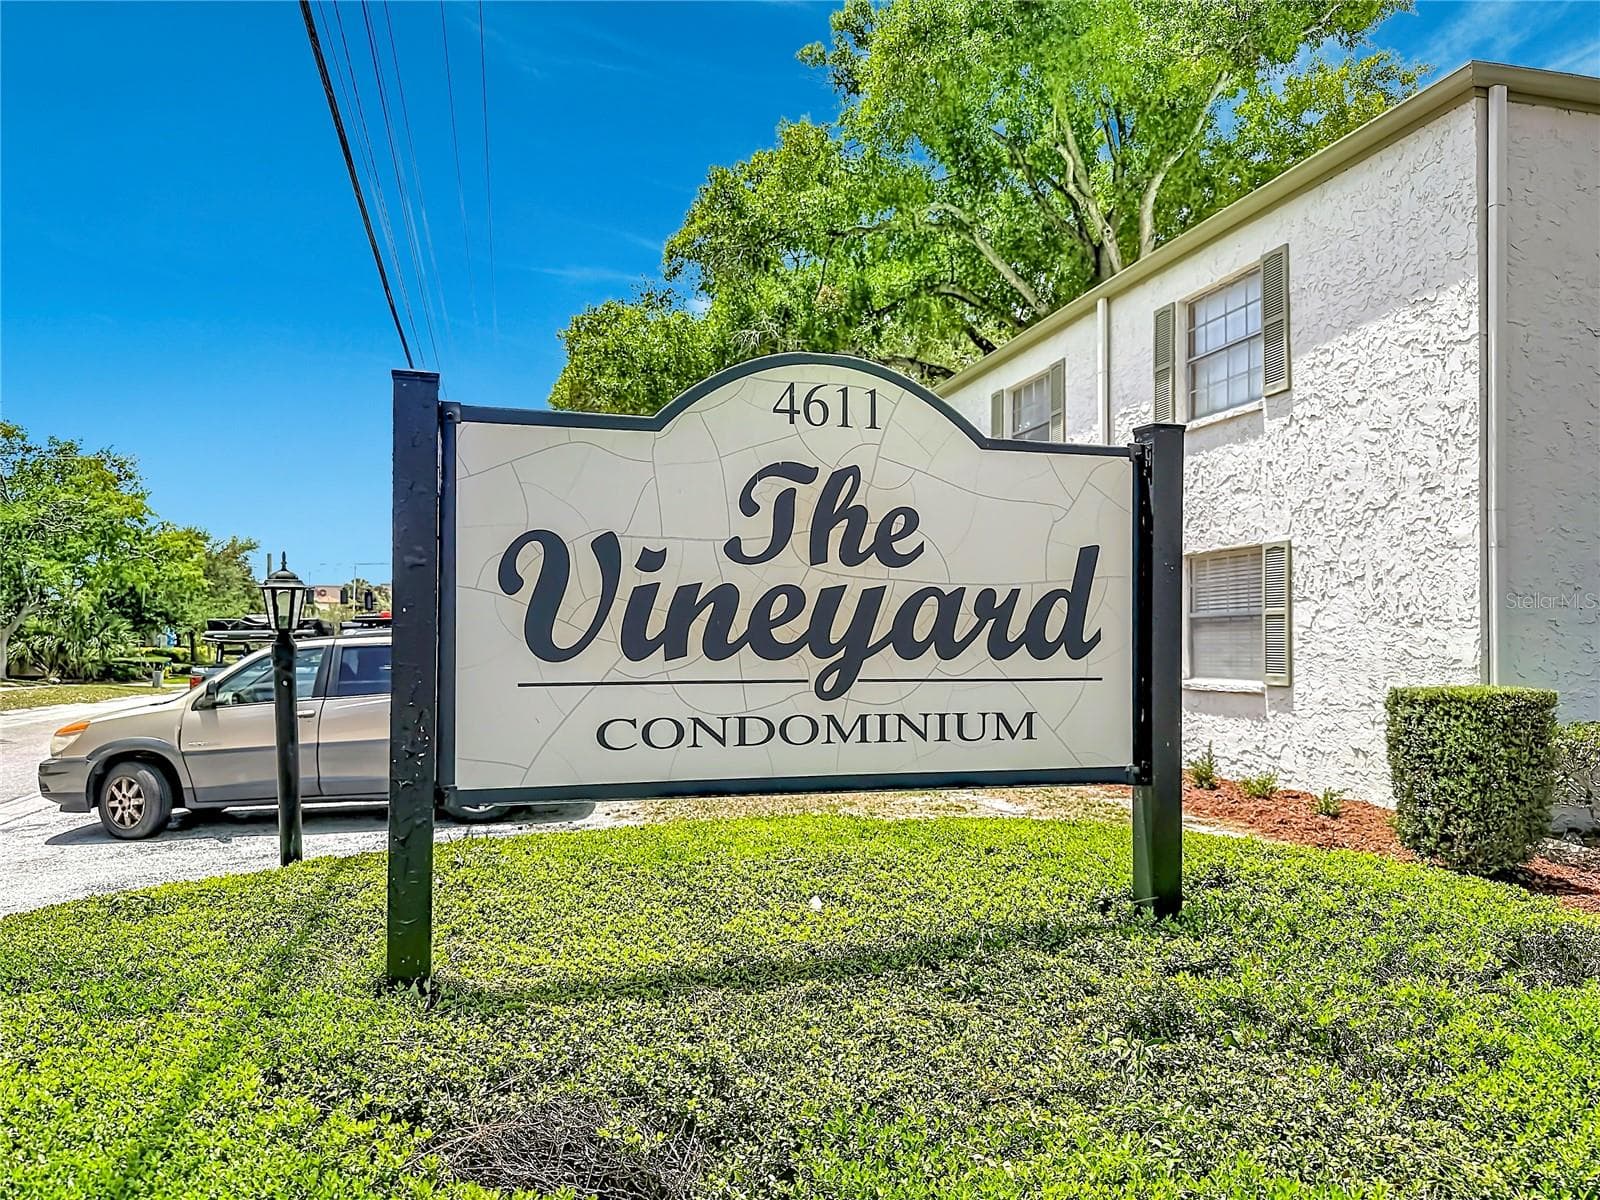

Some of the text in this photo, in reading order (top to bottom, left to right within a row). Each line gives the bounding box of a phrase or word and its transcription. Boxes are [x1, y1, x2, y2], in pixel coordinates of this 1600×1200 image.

[773, 383, 881, 430] 4611
[724, 462, 925, 569] The
[498, 530, 1101, 701] Vineyard
[596, 712, 1038, 751] CONDOMINIUM
